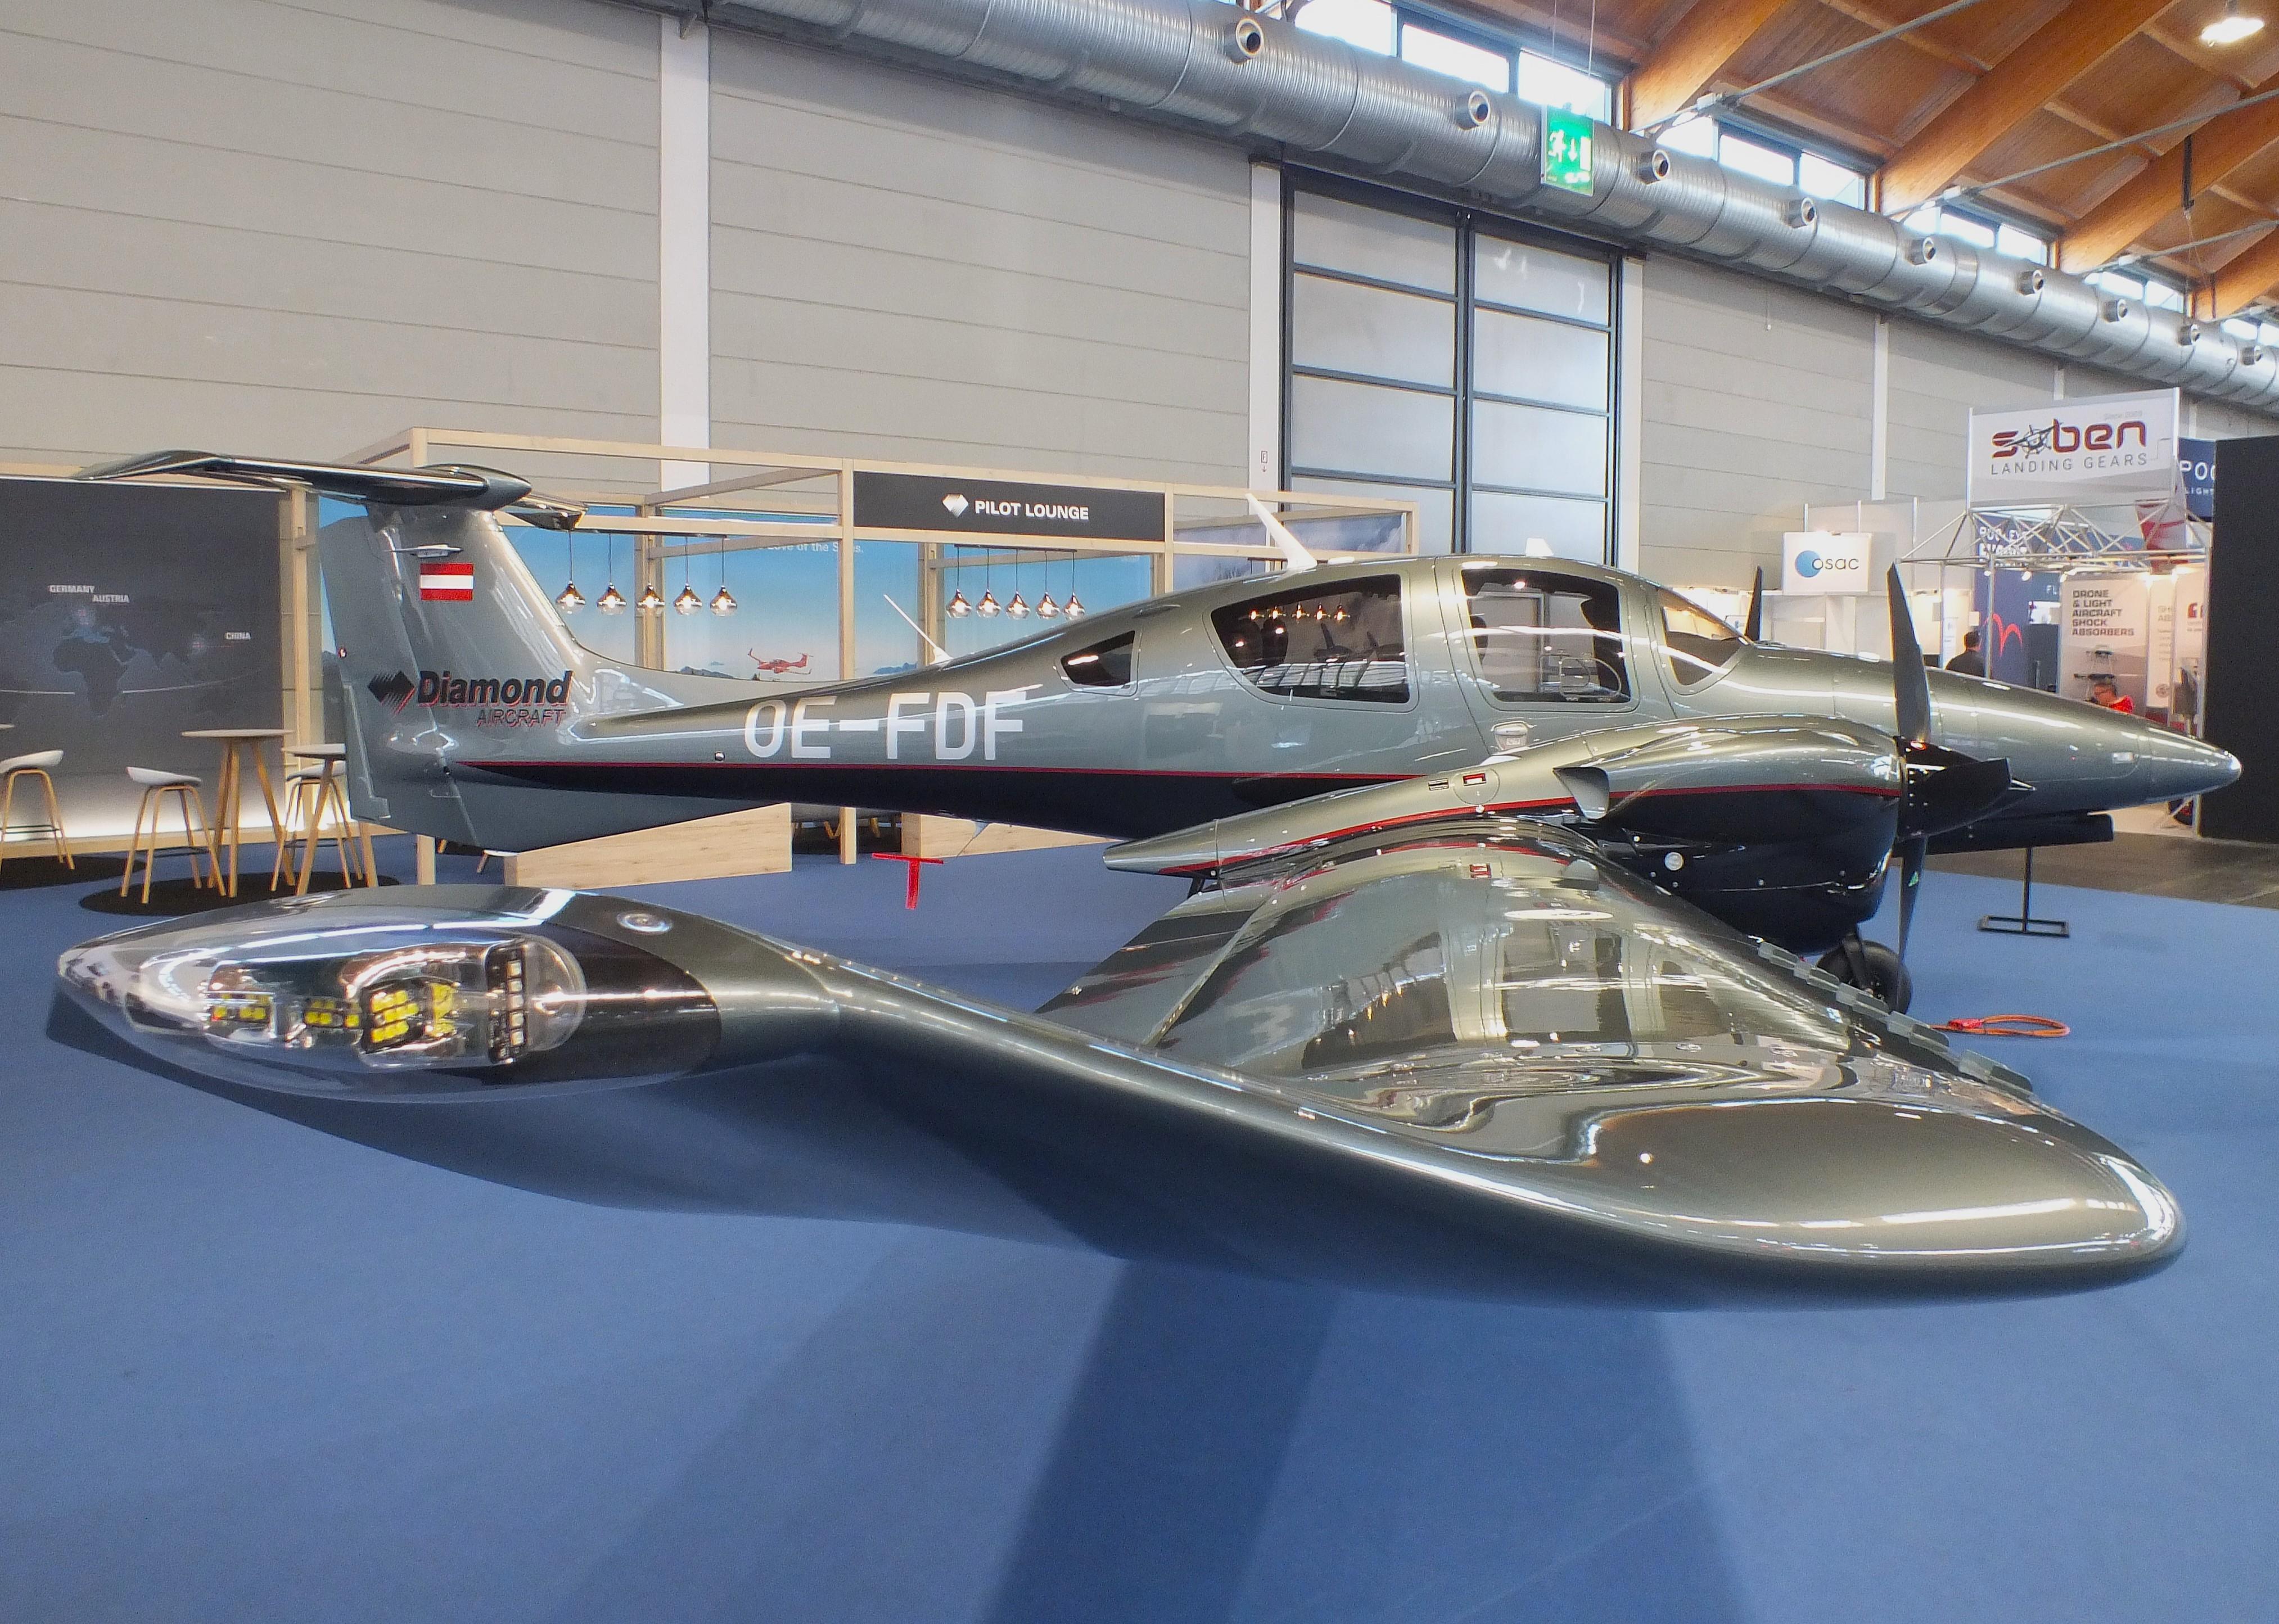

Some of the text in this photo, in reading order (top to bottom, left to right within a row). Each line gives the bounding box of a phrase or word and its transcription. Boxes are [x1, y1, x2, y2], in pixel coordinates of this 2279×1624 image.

[1991, 453, 2147, 476] LANDING GEARS
[974, 500, 1089, 520] PILOT LOUNGE
[811, 542, 829, 552] the
[1812, 557, 1860, 570] osac
[49, 585, 95, 593] GERMANY
[2073, 590, 2109, 598] DRONE
[93, 594, 130, 603] AUSTRIA
[2073, 599, 2112, 608] & LIGHT
[225, 632, 251, 640] CHINA
[2072, 628, 2134, 636] ABSORBERS
[417, 670, 574, 706] Diamond
[477, 708, 566, 727] AIRCRAFT
[744, 691, 1026, 760] OE-FDF
